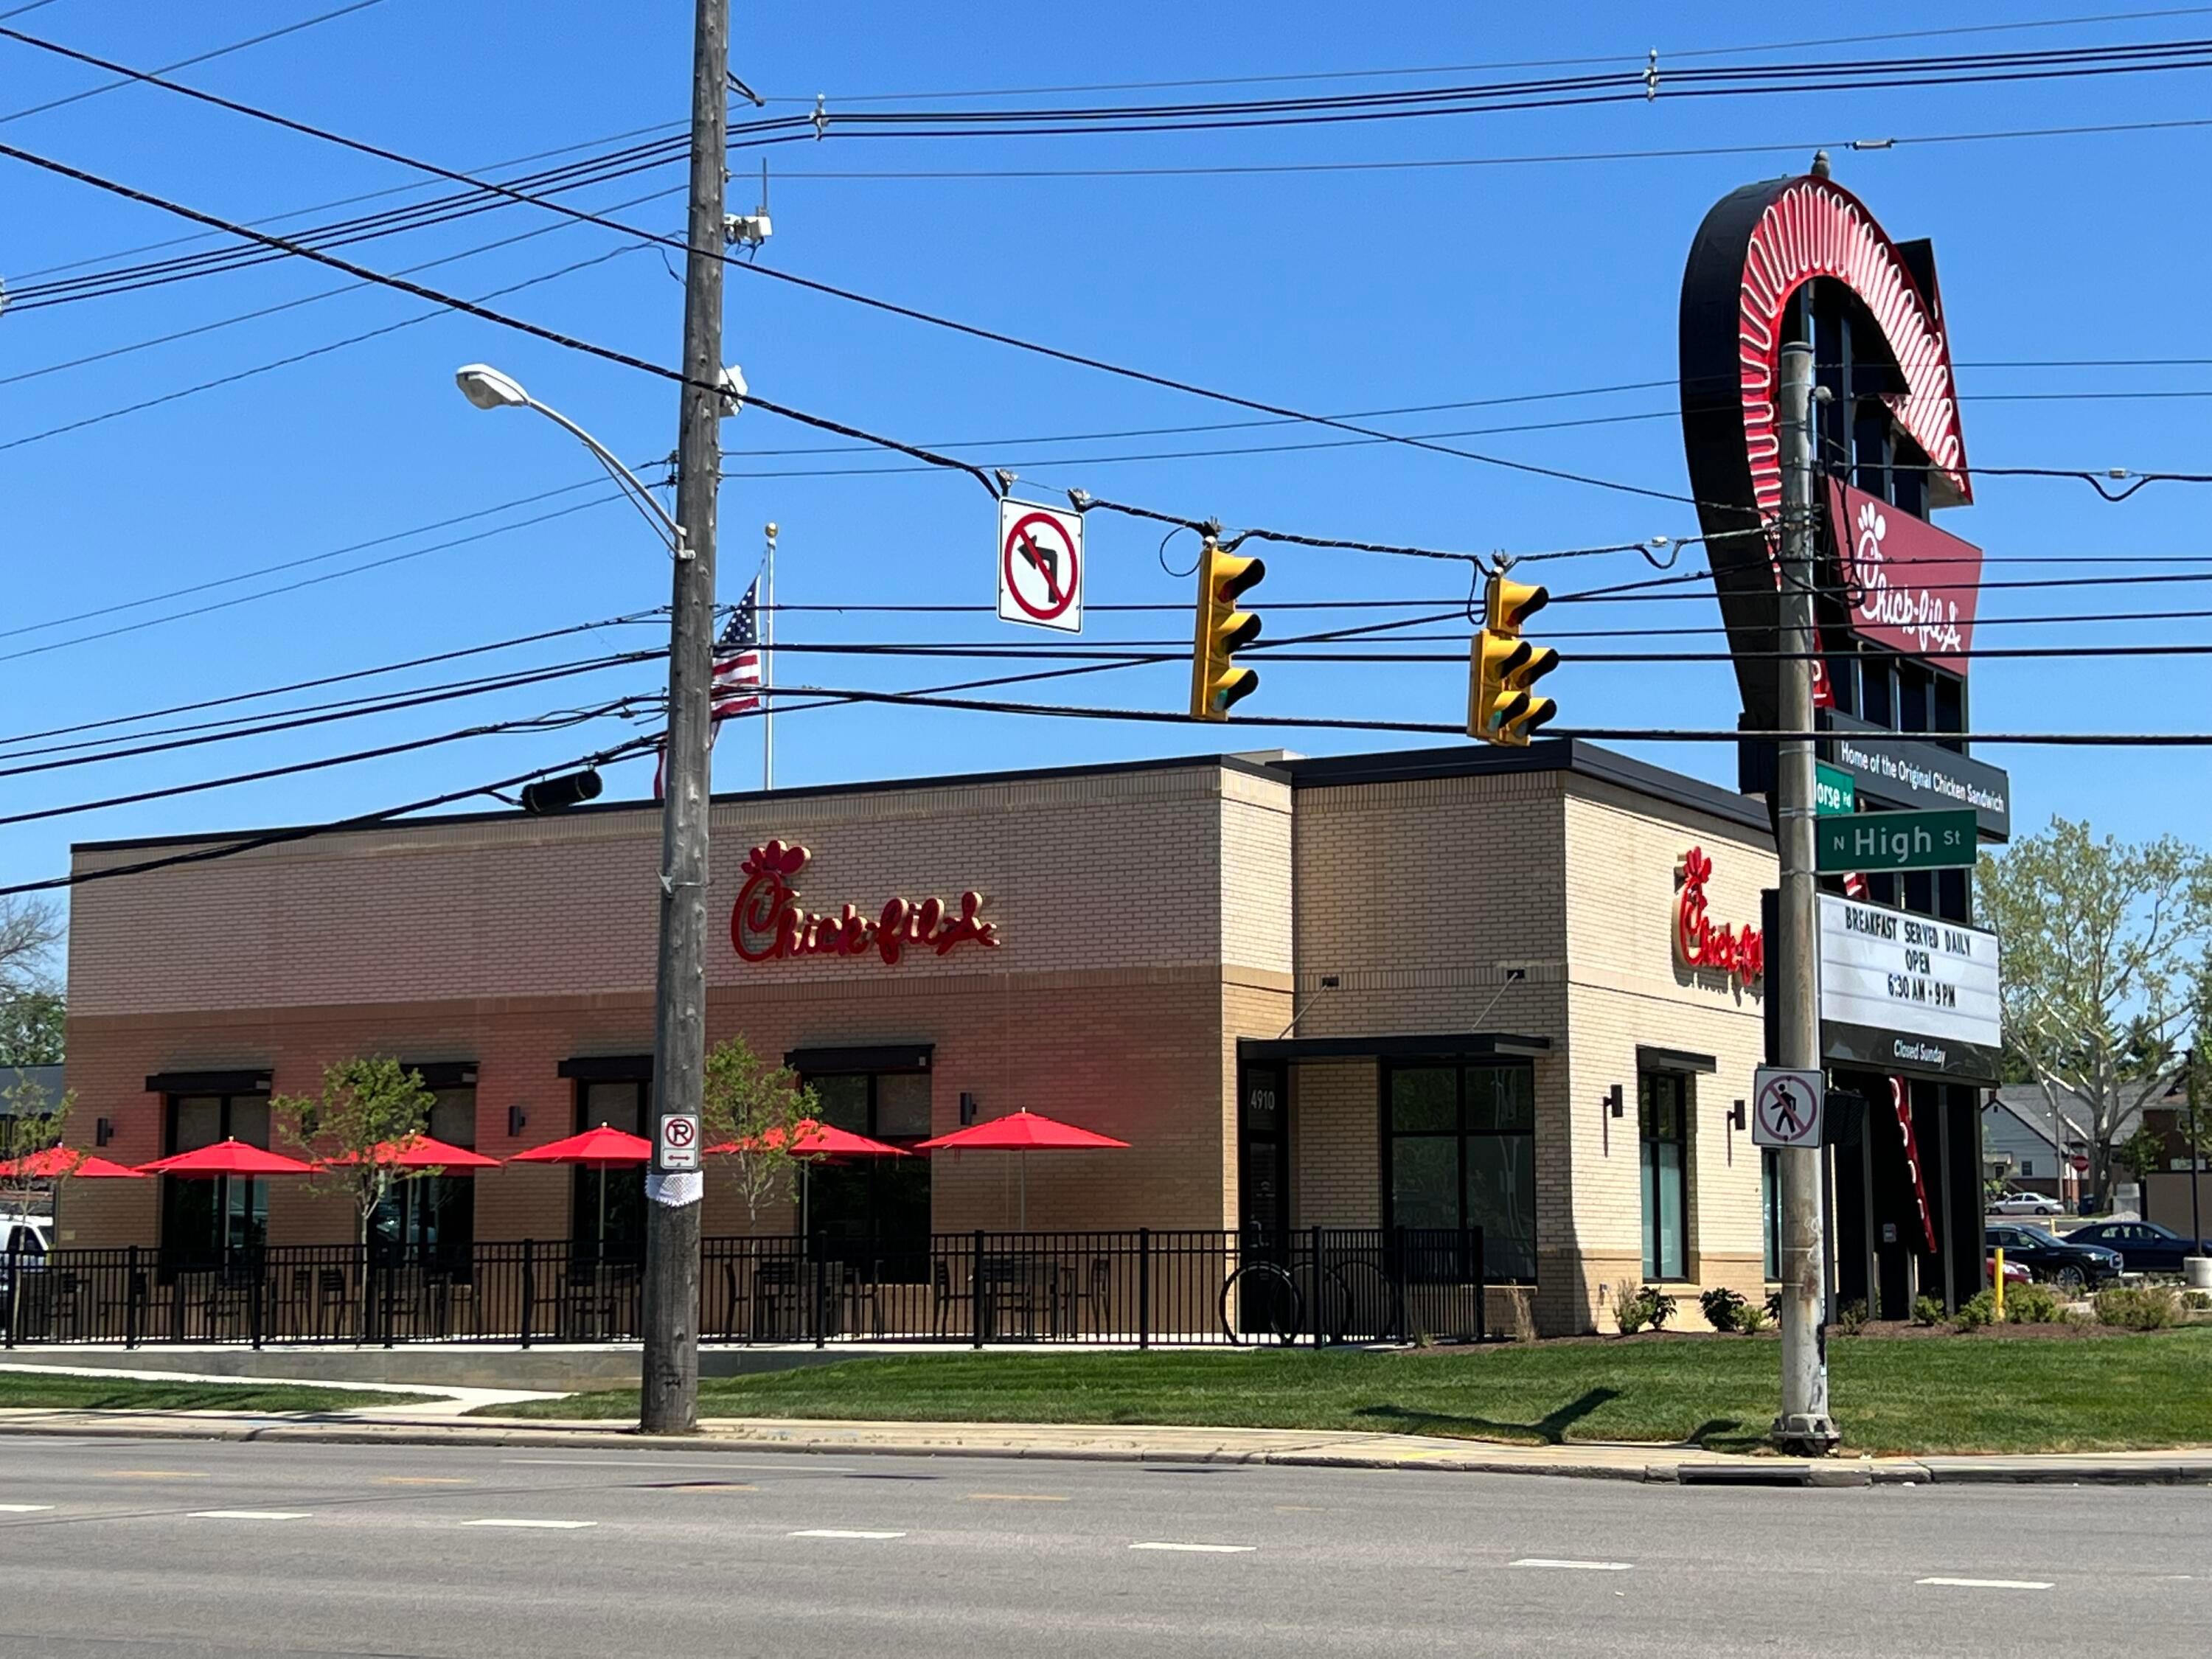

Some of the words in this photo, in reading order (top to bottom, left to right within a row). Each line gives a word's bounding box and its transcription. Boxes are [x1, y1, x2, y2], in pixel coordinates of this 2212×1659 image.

[1857, 529, 1961, 653] Chick-fil-A
[1841, 740, 1868, 770] Home
[1870, 753, 1880, 774] of
[1882, 754, 1897, 779] the
[1898, 759, 1932, 790] Original
[1933, 772, 1966, 801] Chicken
[1966, 783, 2005, 813] Sandwich
[1817, 782, 1840, 810] orse
[1834, 835, 1845, 851] N
[1855, 826, 1932, 863] High
[1944, 830, 1961, 846] St
[731, 869, 1001, 964] Chick-fil-A
[1845, 906, 1897, 940] BREAKFAST
[1905, 921, 1938, 949] SERVED
[1944, 930, 1971, 956] DAILY
[1905, 949, 1930, 975] OPEN
[1888, 973, 1910, 1000] 6:30
[1911, 978, 1926, 1002] AM
[1935, 981, 1941, 1005] 9
[1942, 983, 1956, 1008] PM
[1893, 1039, 1919, 1060] Closed
[1919, 1043, 1947, 1069] Sunday
[1251, 1089, 1276, 1110] 4910
